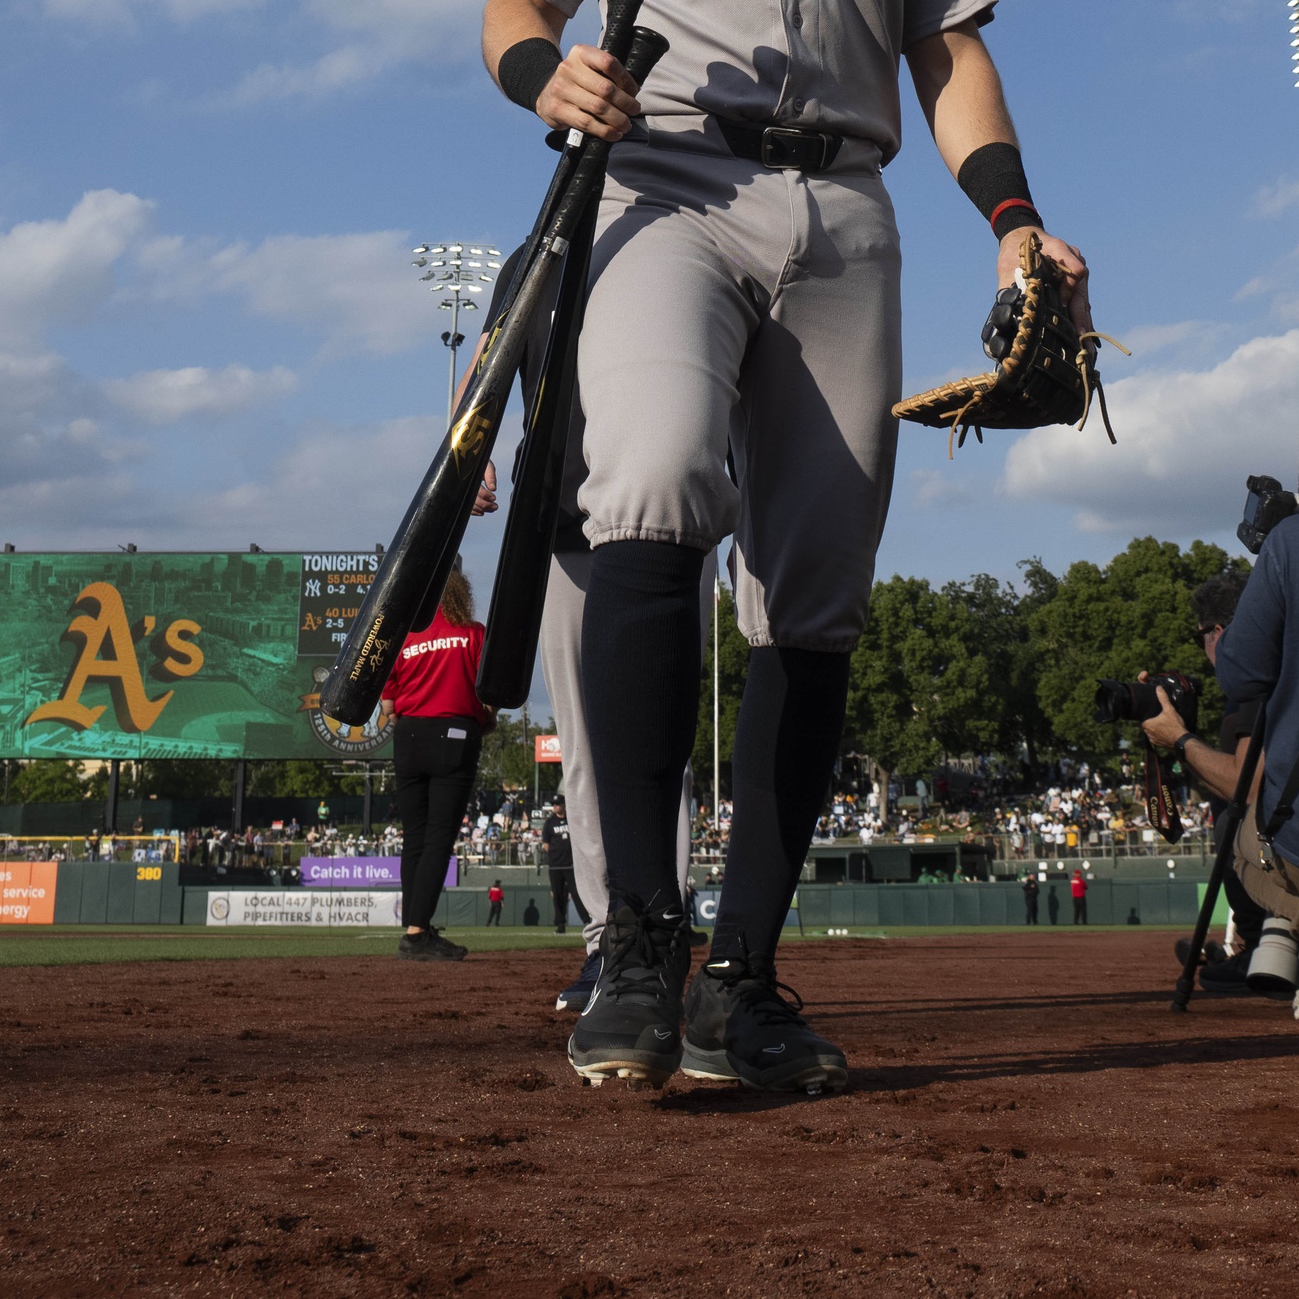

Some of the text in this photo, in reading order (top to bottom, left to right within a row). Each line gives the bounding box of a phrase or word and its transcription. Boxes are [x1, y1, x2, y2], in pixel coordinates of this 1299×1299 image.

[303, 554, 379, 572] TONIGHT'S
[327, 574, 340, 584] 55
[327, 584, 346, 594] 0-2
[325, 608, 340, 618] 40
[301, 613, 322, 630] A's
[326, 618, 344, 628] 2-5
[361, 613, 385, 656] POWERIZED
[403, 637, 469, 660] SECURITY
[26, 581, 205, 732] A's
[349, 655, 366, 681] MAPLE
[313, 713, 396, 752] 125th ANNIVERSARY
[1161, 785, 1173, 816] Canon
[1150, 796, 1159, 827] Canon
[137, 867, 162, 881] 380
[310, 865, 393, 879] Catch it live.
[2, 887, 46, 899] service
[244, 896, 377, 909] LOCAL 447 PLUMBERS,
[243, 912, 369, 924] PIPEFITTERS & HVACR
